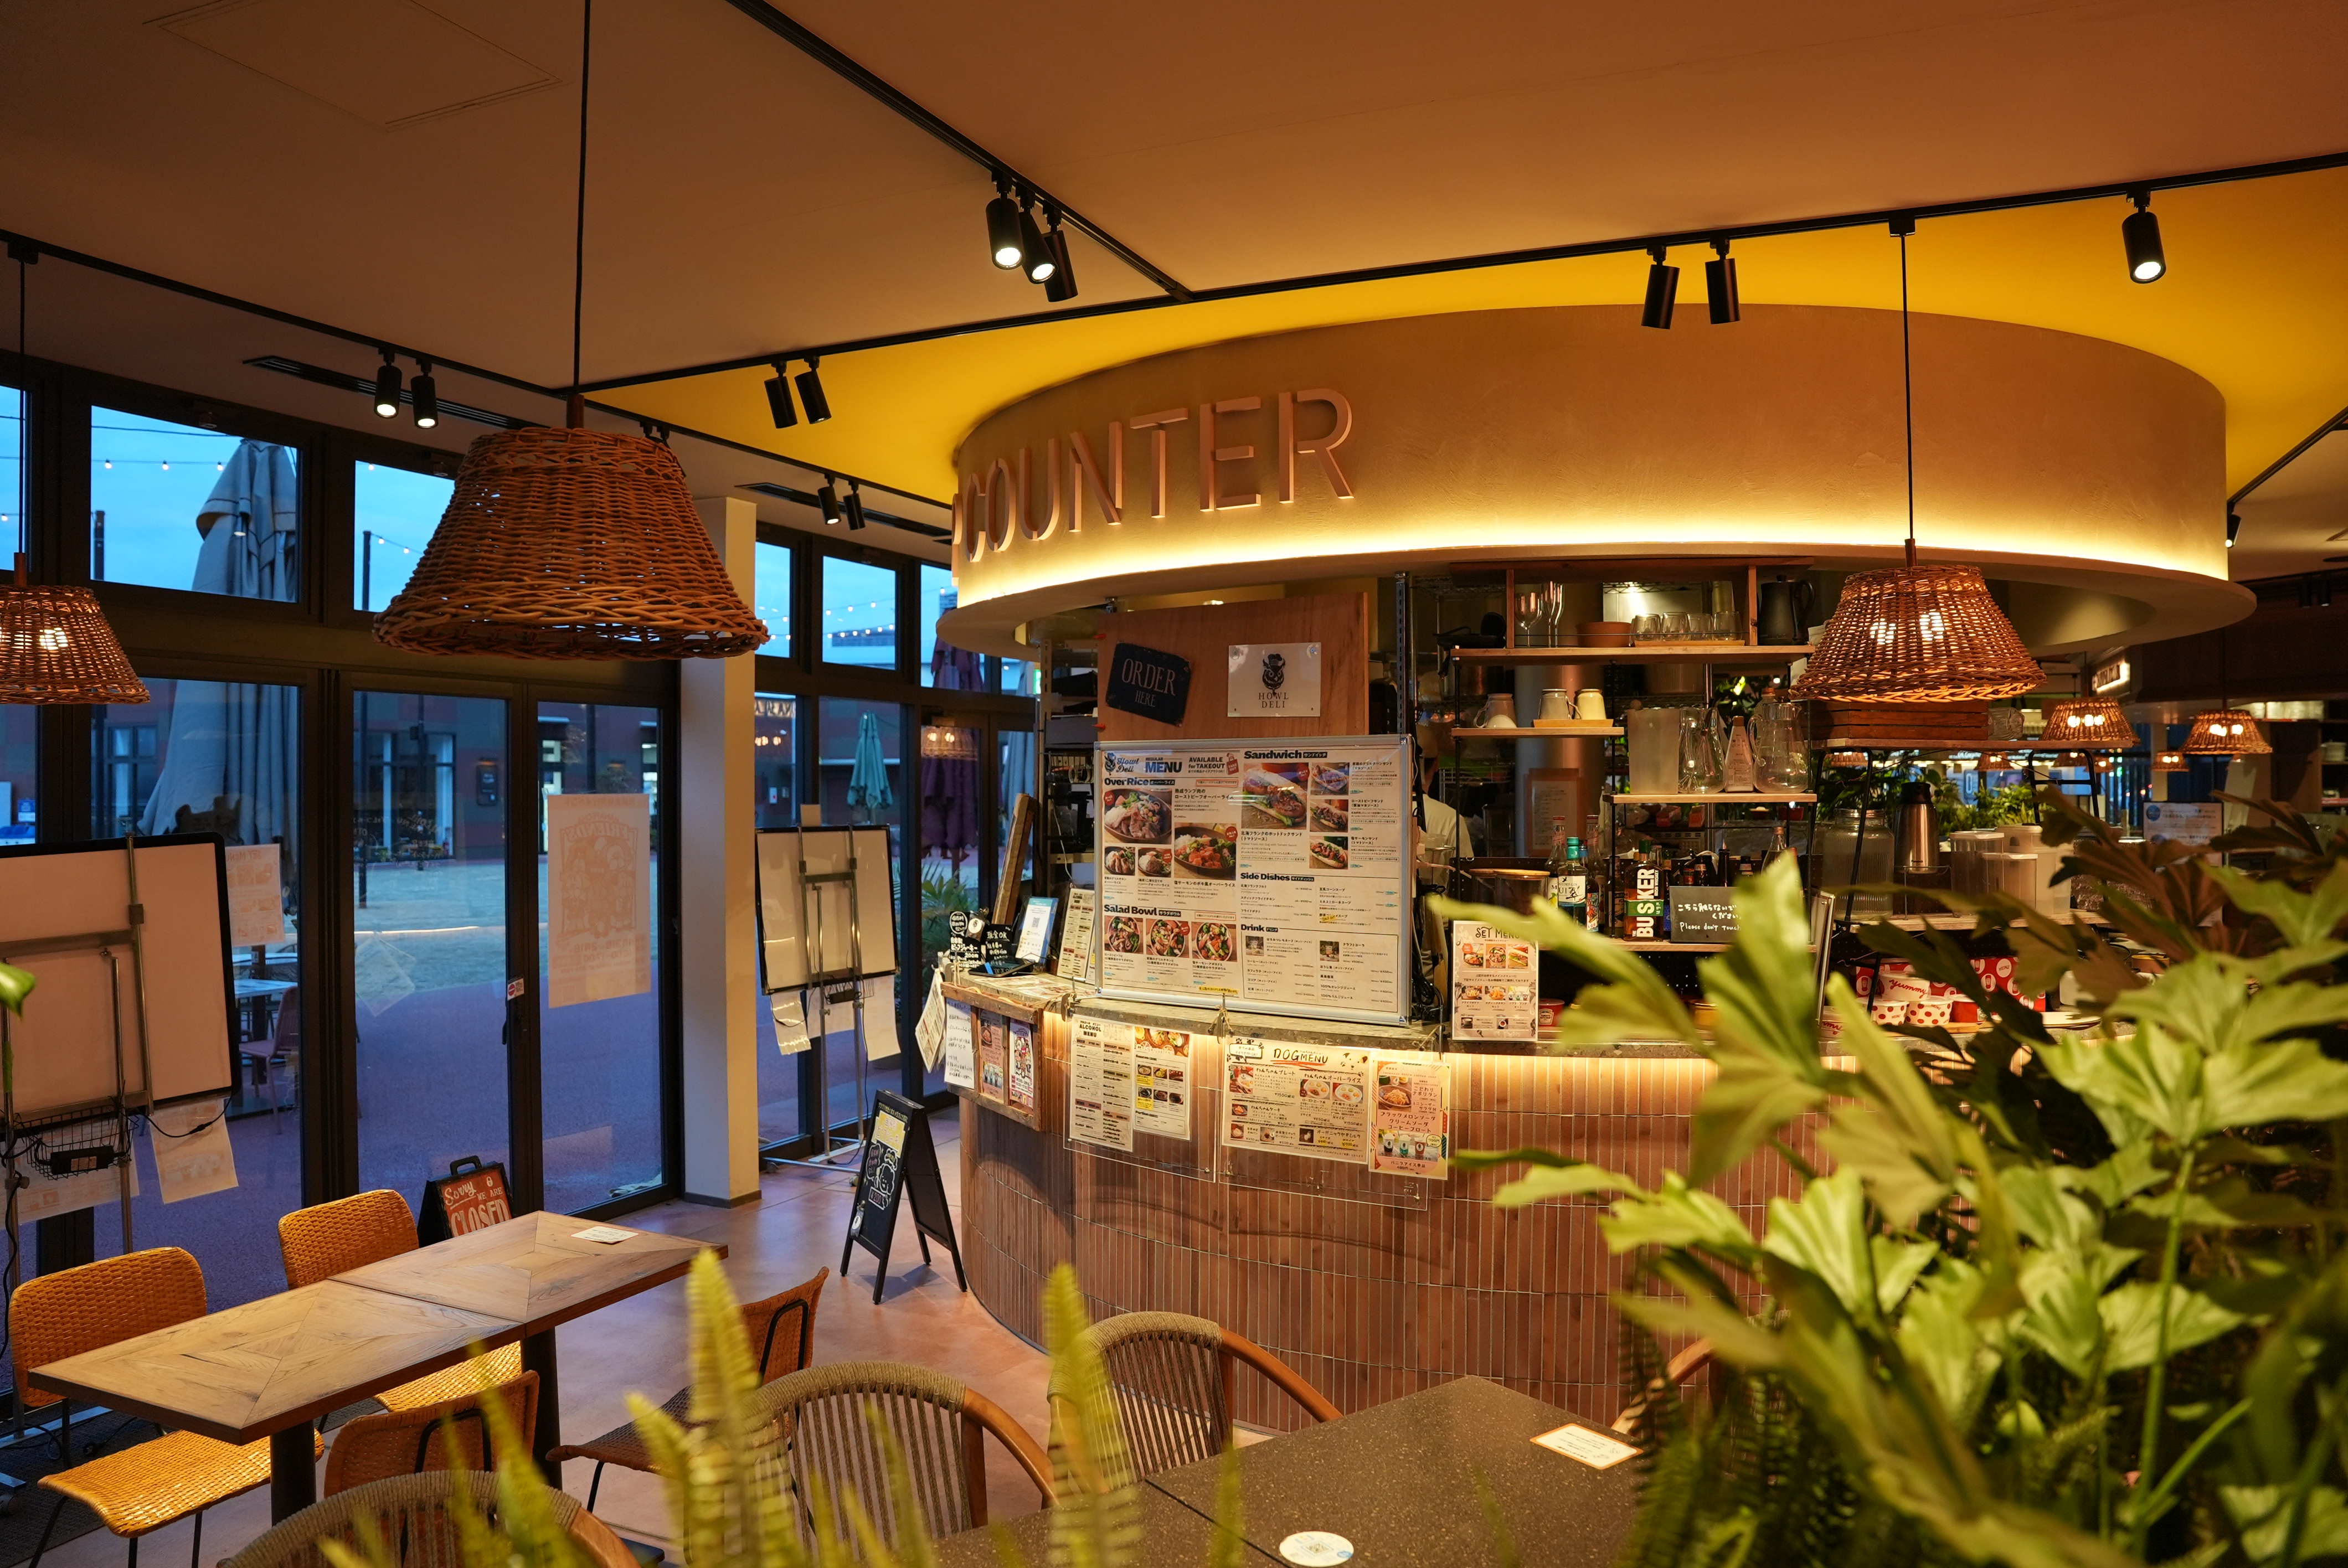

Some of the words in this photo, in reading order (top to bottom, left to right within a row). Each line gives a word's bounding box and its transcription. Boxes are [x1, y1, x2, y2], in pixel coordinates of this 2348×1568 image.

[964, 388, 1355, 563] COUNTER
[1121, 658, 1176, 696] ORDER
[1135, 690, 1156, 708] HERE
[1258, 692, 1289, 702] HOWL
[1261, 700, 1285, 709] DELI
[1244, 750, 1301, 759] Sandwich
[1145, 761, 1182, 773] MENU
[1127, 777, 1149, 786] Rice
[1261, 873, 1290, 881] Dishes
[1636, 869, 1655, 937] BUSKER
[1104, 905, 1130, 914] Salad
[1131, 906, 1157, 916] Bowl
[1476, 926, 1492, 938] SET
[1680, 922, 1701, 932] Please
[1889, 979, 1928, 999] yummy
[1274, 1048, 1299, 1062] DOG
[1300, 1054, 1329, 1064] MENU
[1305, 1074, 1361, 1084] わんちゃんオーバーライス
[444, 1181, 477, 1206] Sorry
[477, 1190, 486, 1201] WE
[490, 1187, 503, 1197] ARE
[451, 1198, 511, 1236] CLOSED
